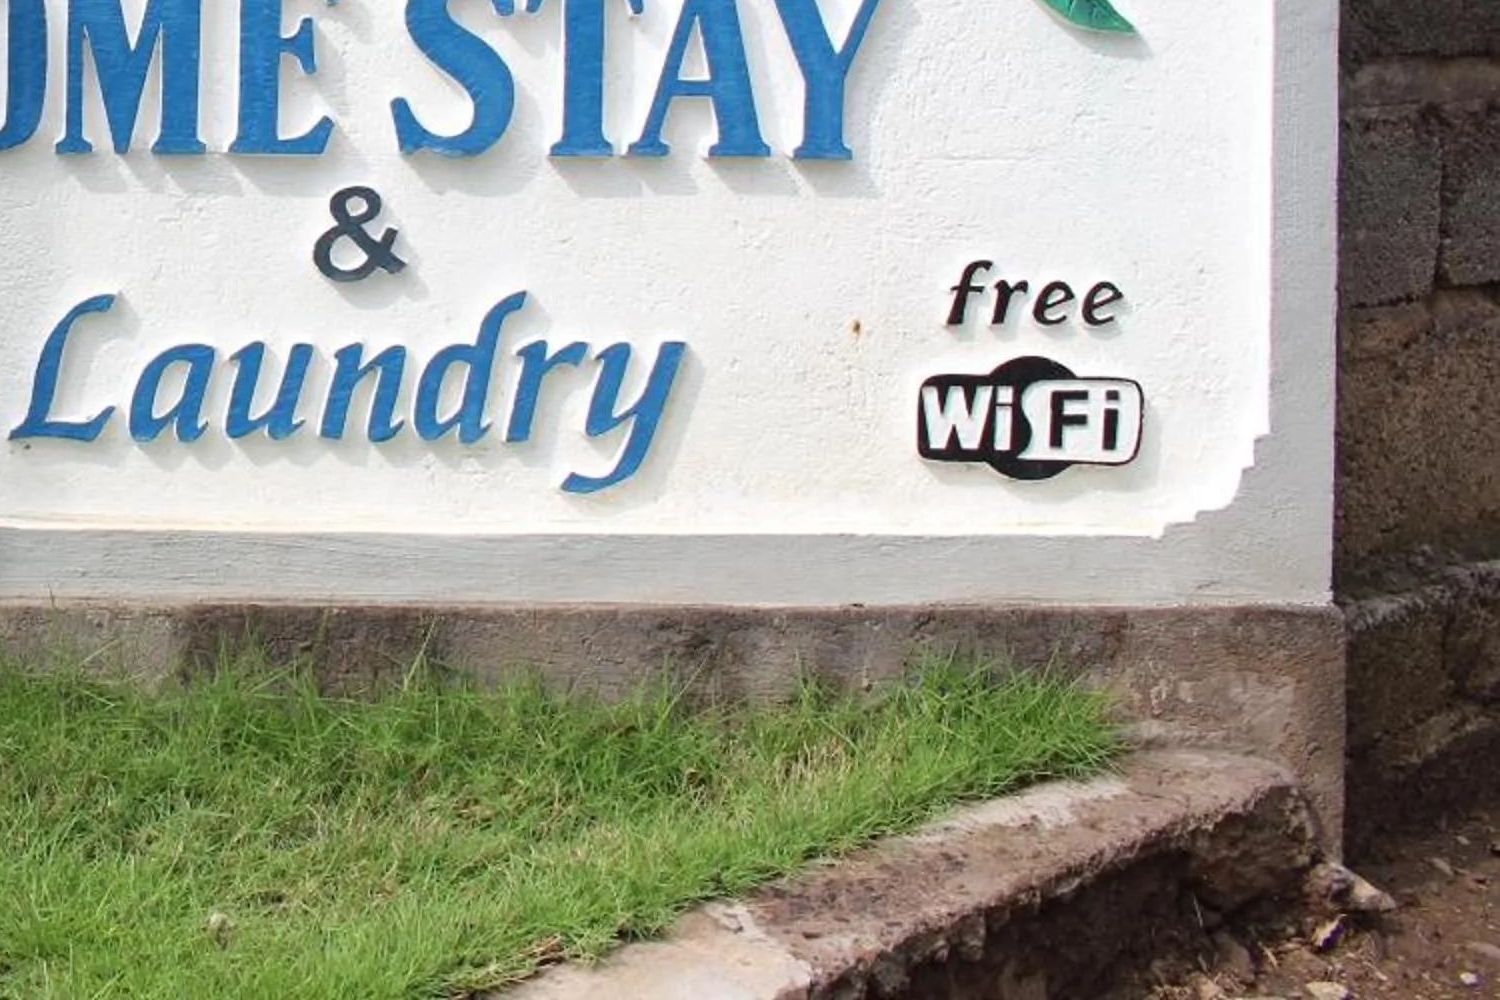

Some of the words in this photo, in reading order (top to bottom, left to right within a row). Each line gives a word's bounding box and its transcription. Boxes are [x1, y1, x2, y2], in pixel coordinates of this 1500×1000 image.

[313, 186, 407, 283] &
[946, 260, 1124, 326] free
[8, 290, 686, 493] Laundry
